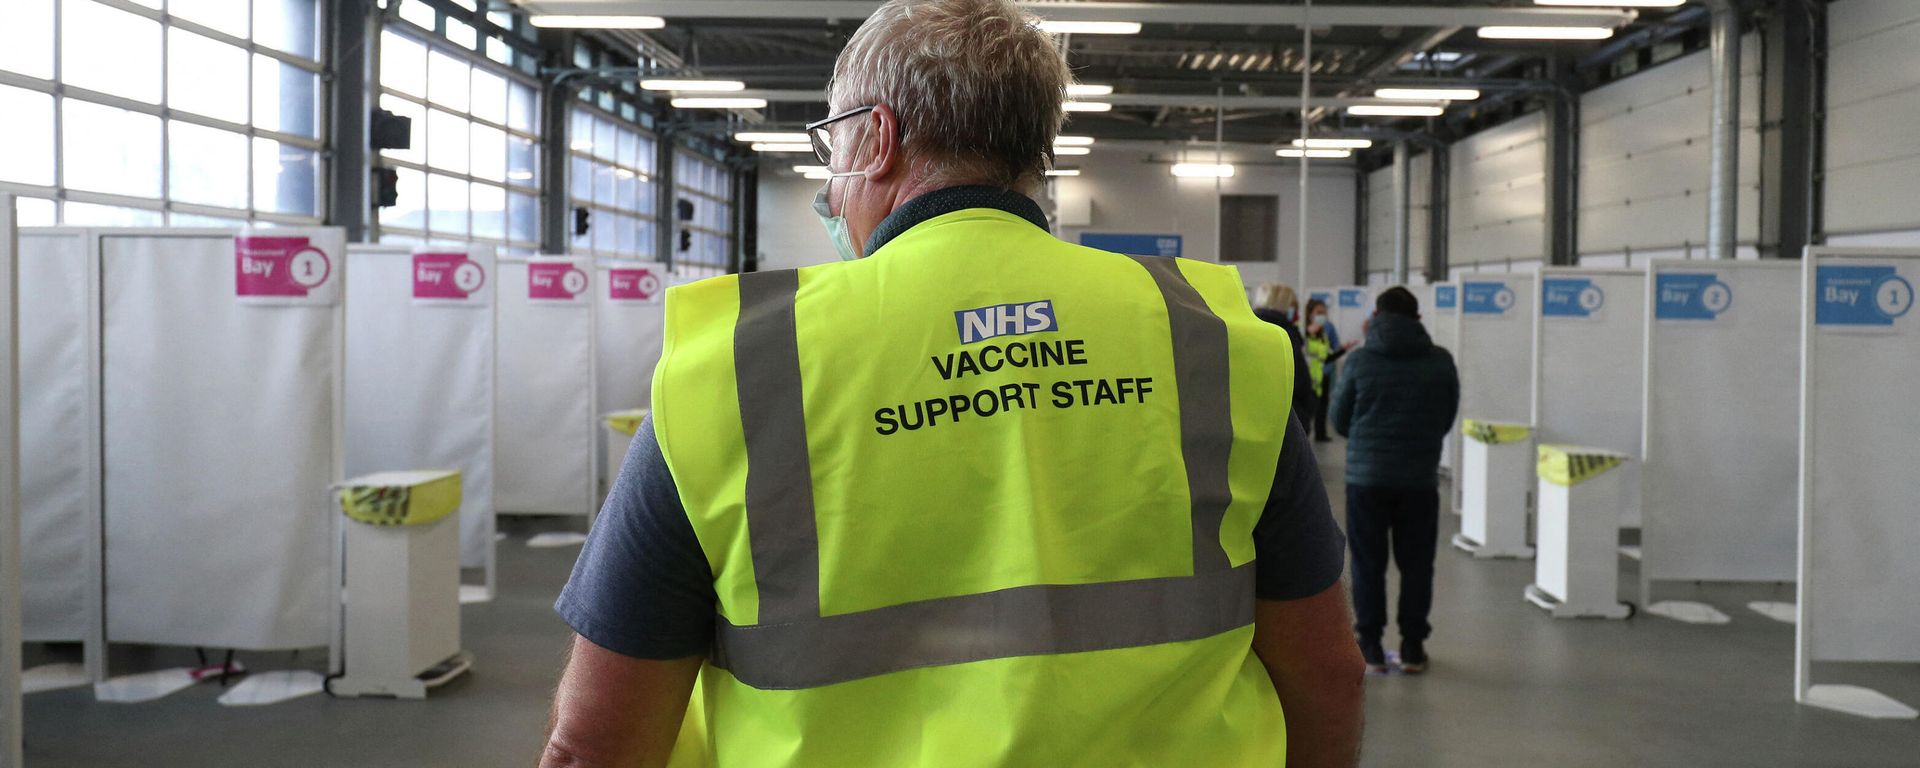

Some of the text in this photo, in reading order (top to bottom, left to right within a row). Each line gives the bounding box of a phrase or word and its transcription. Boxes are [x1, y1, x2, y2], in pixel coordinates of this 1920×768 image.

[242, 257, 274, 278] Bay
[304, 261, 312, 276] 1
[417, 268, 443, 286] Bay
[463, 270, 472, 284] 2
[1662, 288, 1689, 306] Bay
[1711, 291, 1720, 304] 2
[1824, 286, 1860, 307] Bay
[1889, 289, 1898, 306] 1
[962, 301, 1052, 343] NHS
[931, 339, 1088, 381] VACCINE
[874, 377, 1153, 436] SUPPORT STAFF
